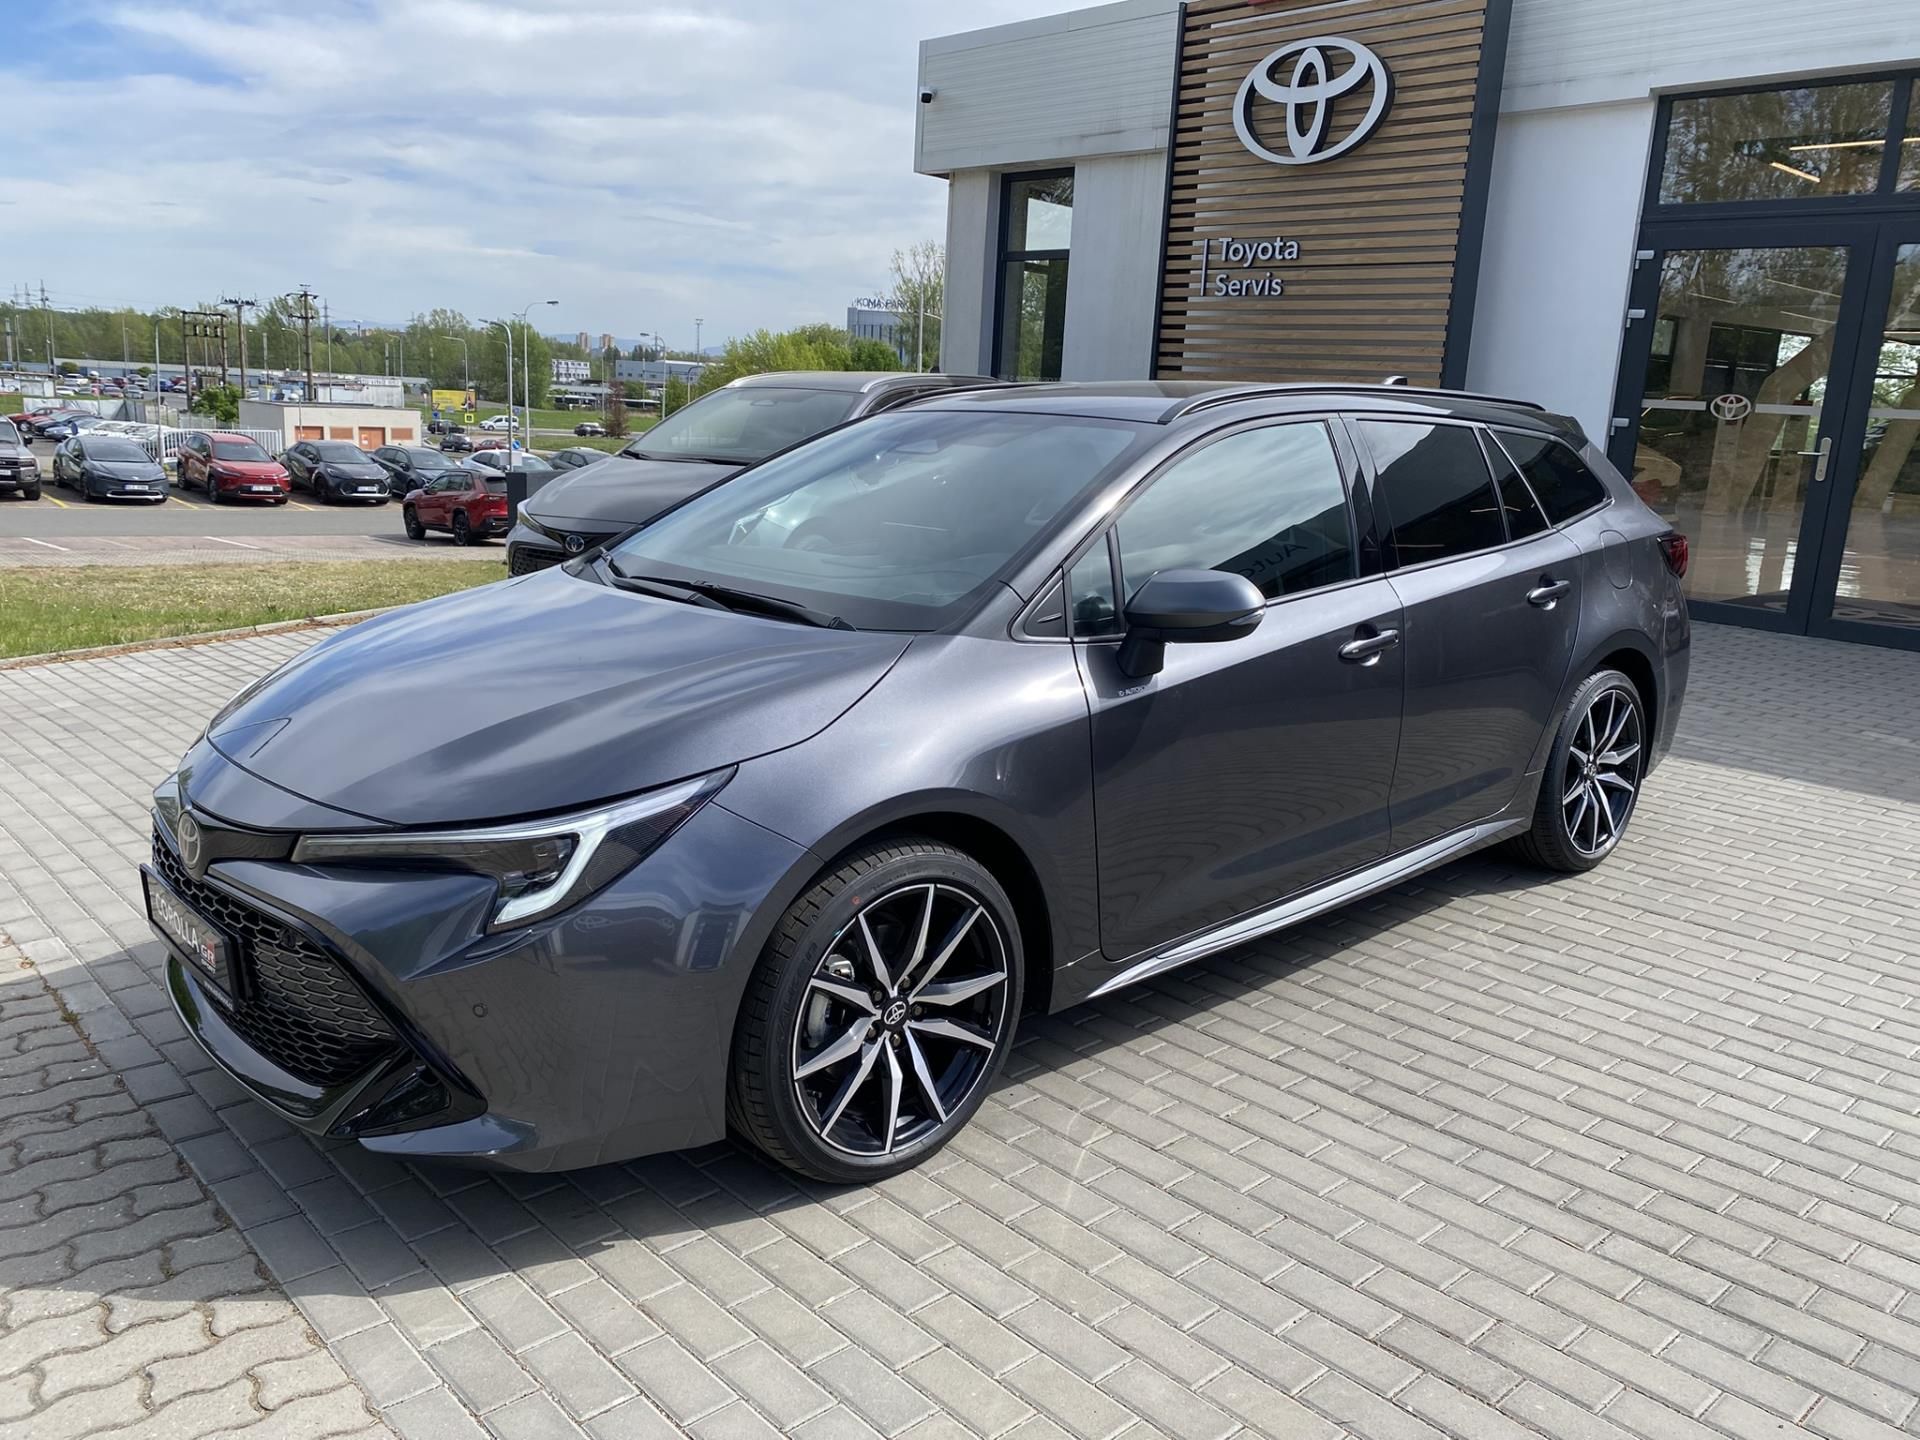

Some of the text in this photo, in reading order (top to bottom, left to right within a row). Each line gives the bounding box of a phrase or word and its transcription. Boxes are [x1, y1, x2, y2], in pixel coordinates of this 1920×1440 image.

[1218, 236, 1299, 268] Toyota
[1214, 271, 1282, 296] Servis
[155, 893, 216, 966] COROLLA GR
